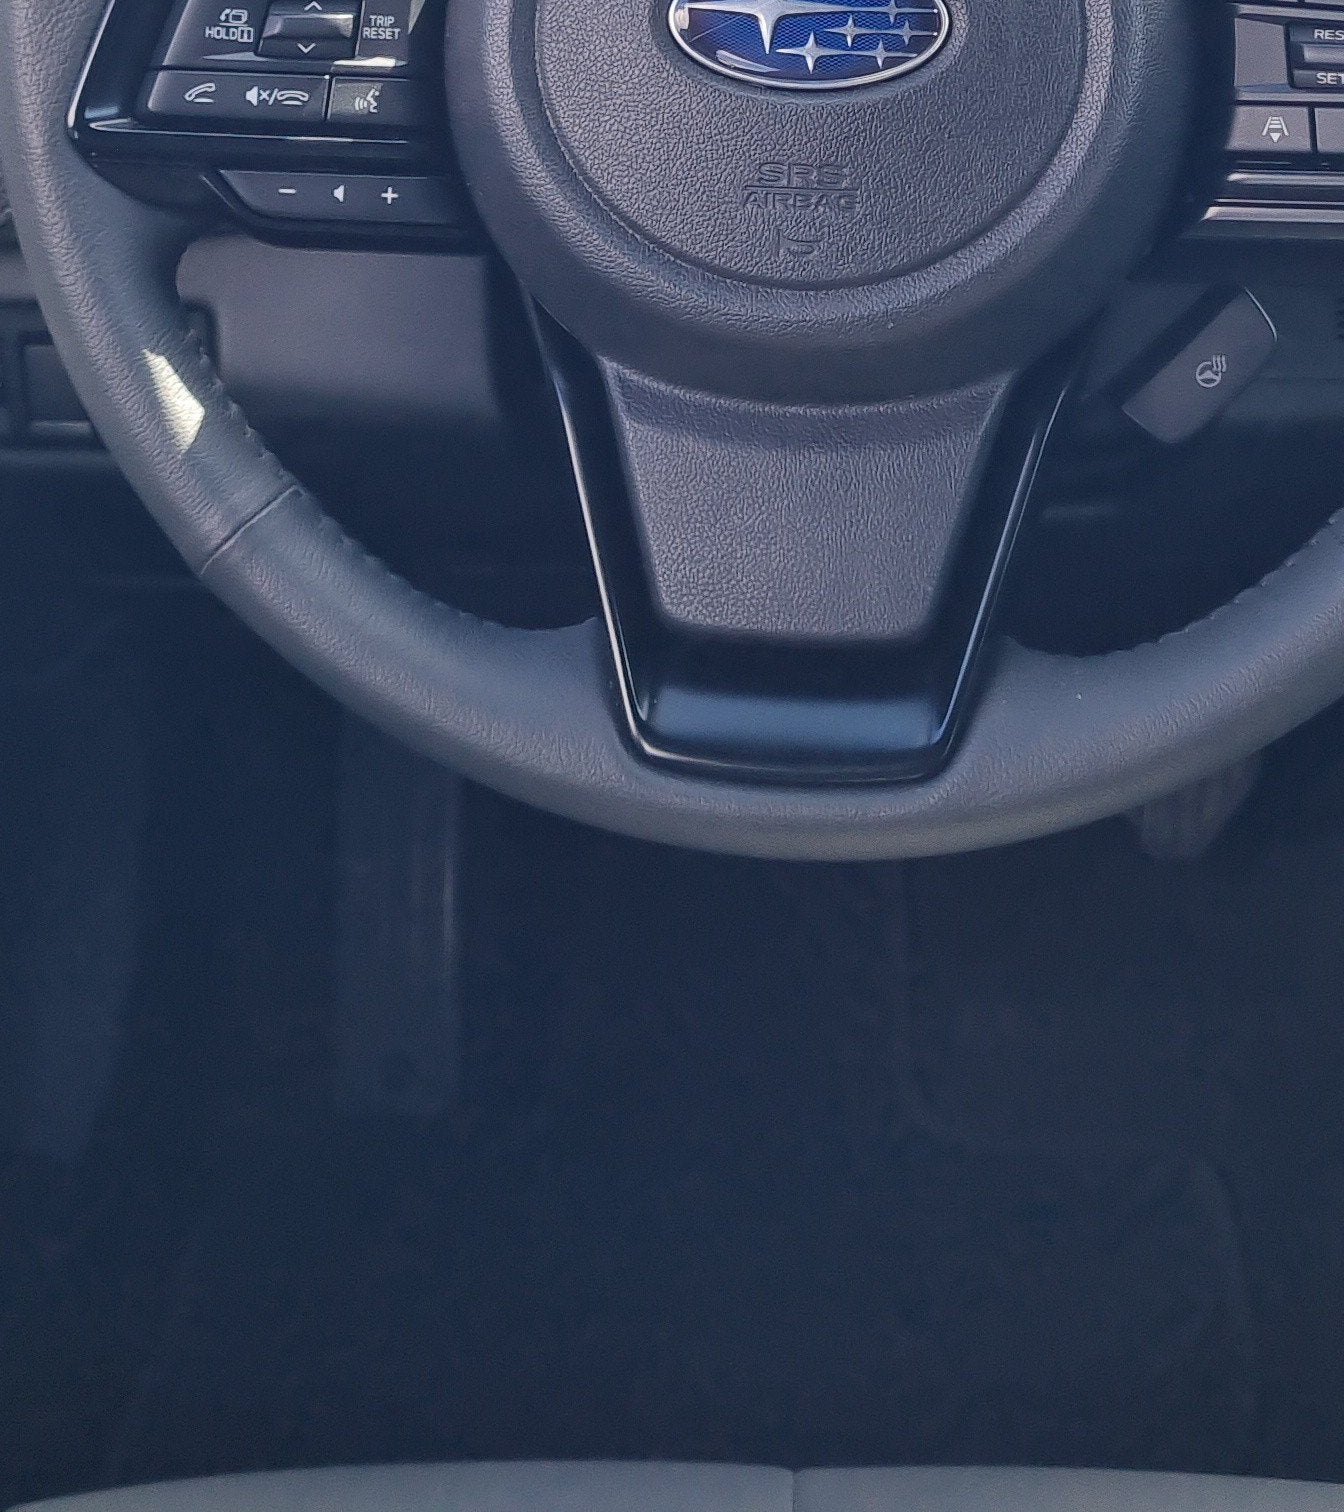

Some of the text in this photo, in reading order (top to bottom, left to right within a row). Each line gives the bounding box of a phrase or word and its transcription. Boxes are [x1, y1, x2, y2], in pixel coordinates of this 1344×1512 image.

[369, 15, 396, 28] TRIP
[205, 26, 238, 40] HOLD
[363, 27, 401, 40] RESET
[758, 162, 844, 186] SRS
[743, 191, 857, 210] AIRBAG
